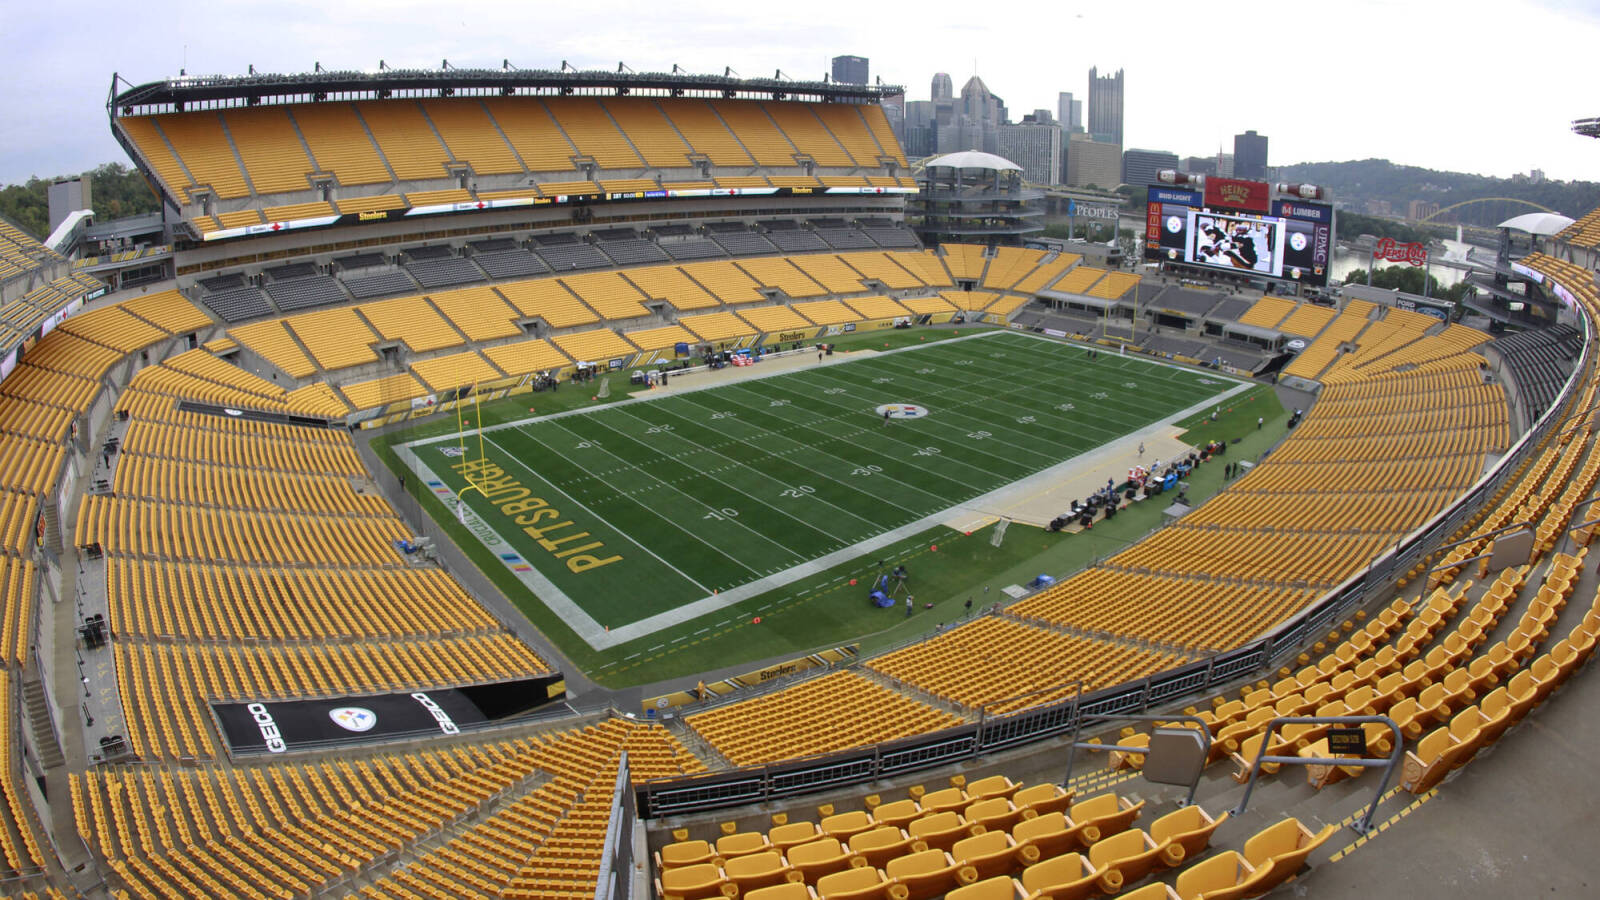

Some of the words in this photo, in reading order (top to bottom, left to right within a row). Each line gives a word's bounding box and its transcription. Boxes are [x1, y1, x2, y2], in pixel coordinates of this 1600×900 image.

[1220, 184, 1250, 198] HEINZ
[1076, 205, 1120, 220] PEOPLES
[1293, 207, 1321, 219] LUMBER
[1316, 227, 1328, 262] UPMC
[451, 457, 624, 574] PITTSBURGH
[760, 664, 796, 681] Steelers
[411, 692, 460, 735] GEICO
[247, 702, 287, 753] GEICO
